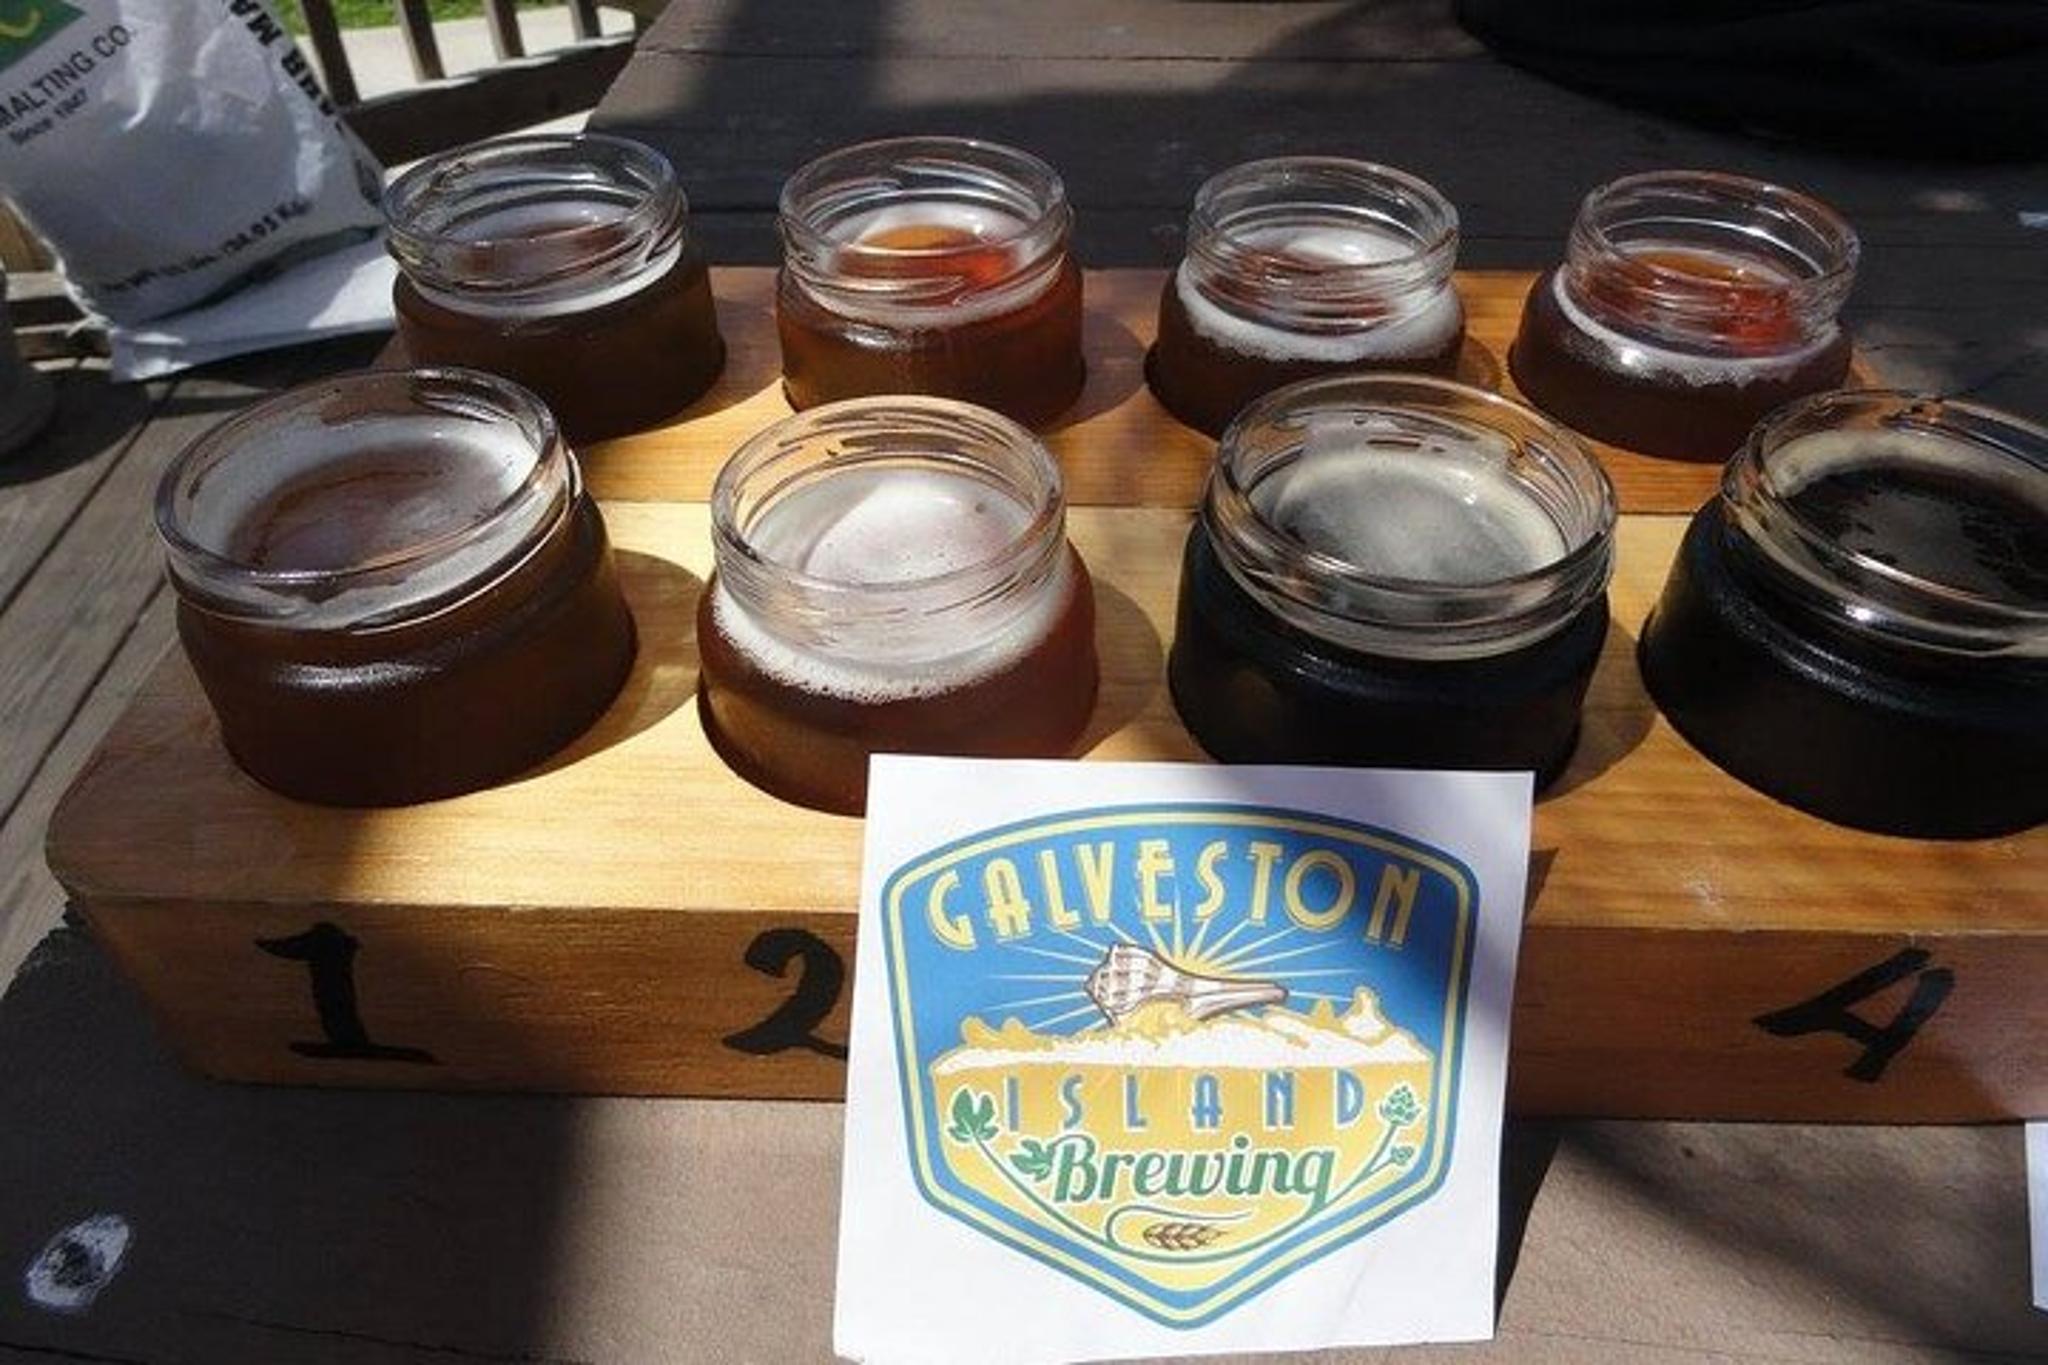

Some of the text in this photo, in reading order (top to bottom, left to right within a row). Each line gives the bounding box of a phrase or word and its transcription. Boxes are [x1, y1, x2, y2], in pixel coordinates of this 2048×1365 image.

[925, 838, 1424, 949] GALVESTON
[255, 922, 1955, 1084] 1 2 4
[1004, 1068, 1365, 1132] ISLAND
[1053, 1135, 1336, 1207] Brewing
